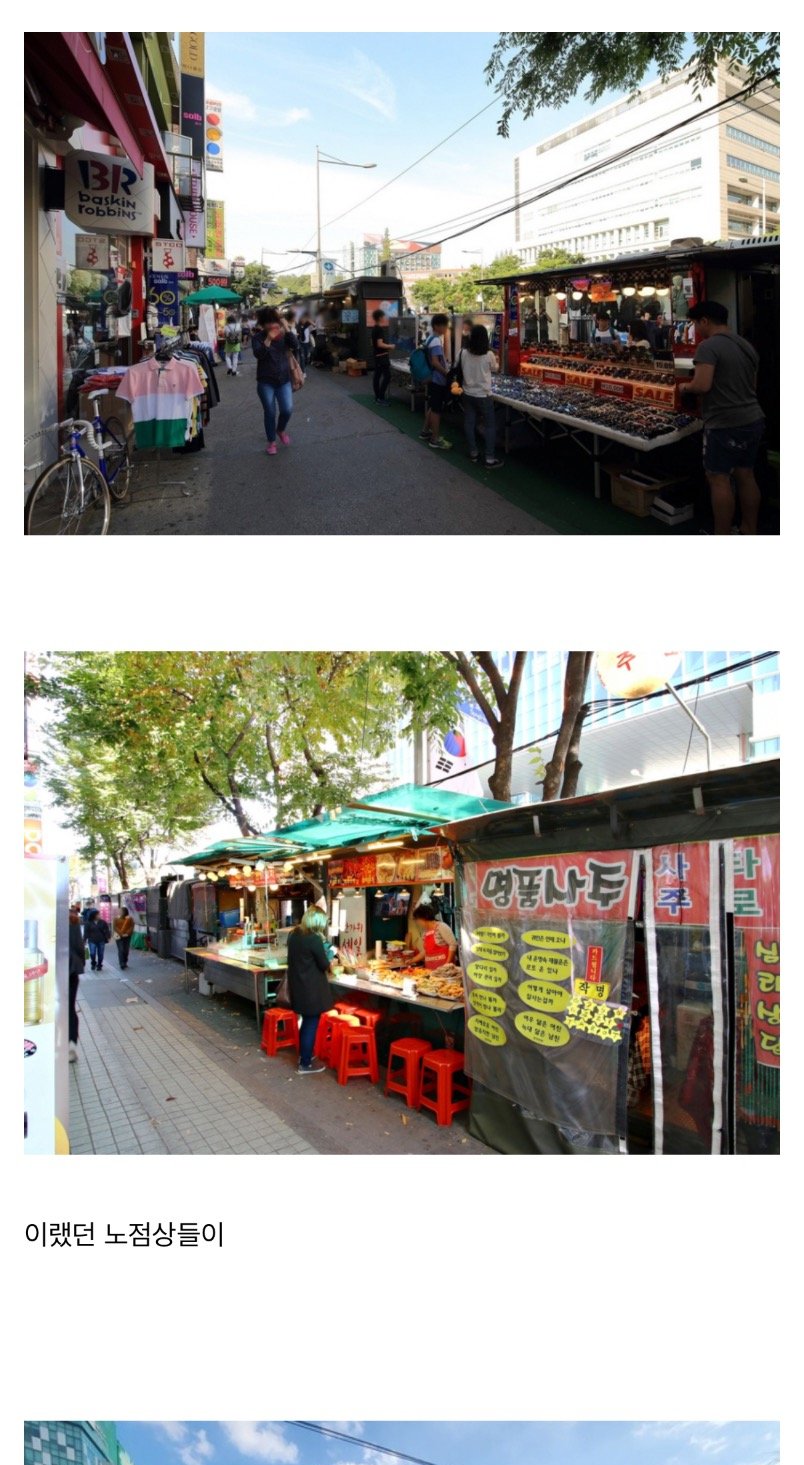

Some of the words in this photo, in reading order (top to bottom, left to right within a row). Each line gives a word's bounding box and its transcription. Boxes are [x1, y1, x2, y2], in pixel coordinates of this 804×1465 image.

[634, 386, 674, 401] SALE
[481, 858, 628, 910] 명품사주
[656, 852, 692, 917] 사주
